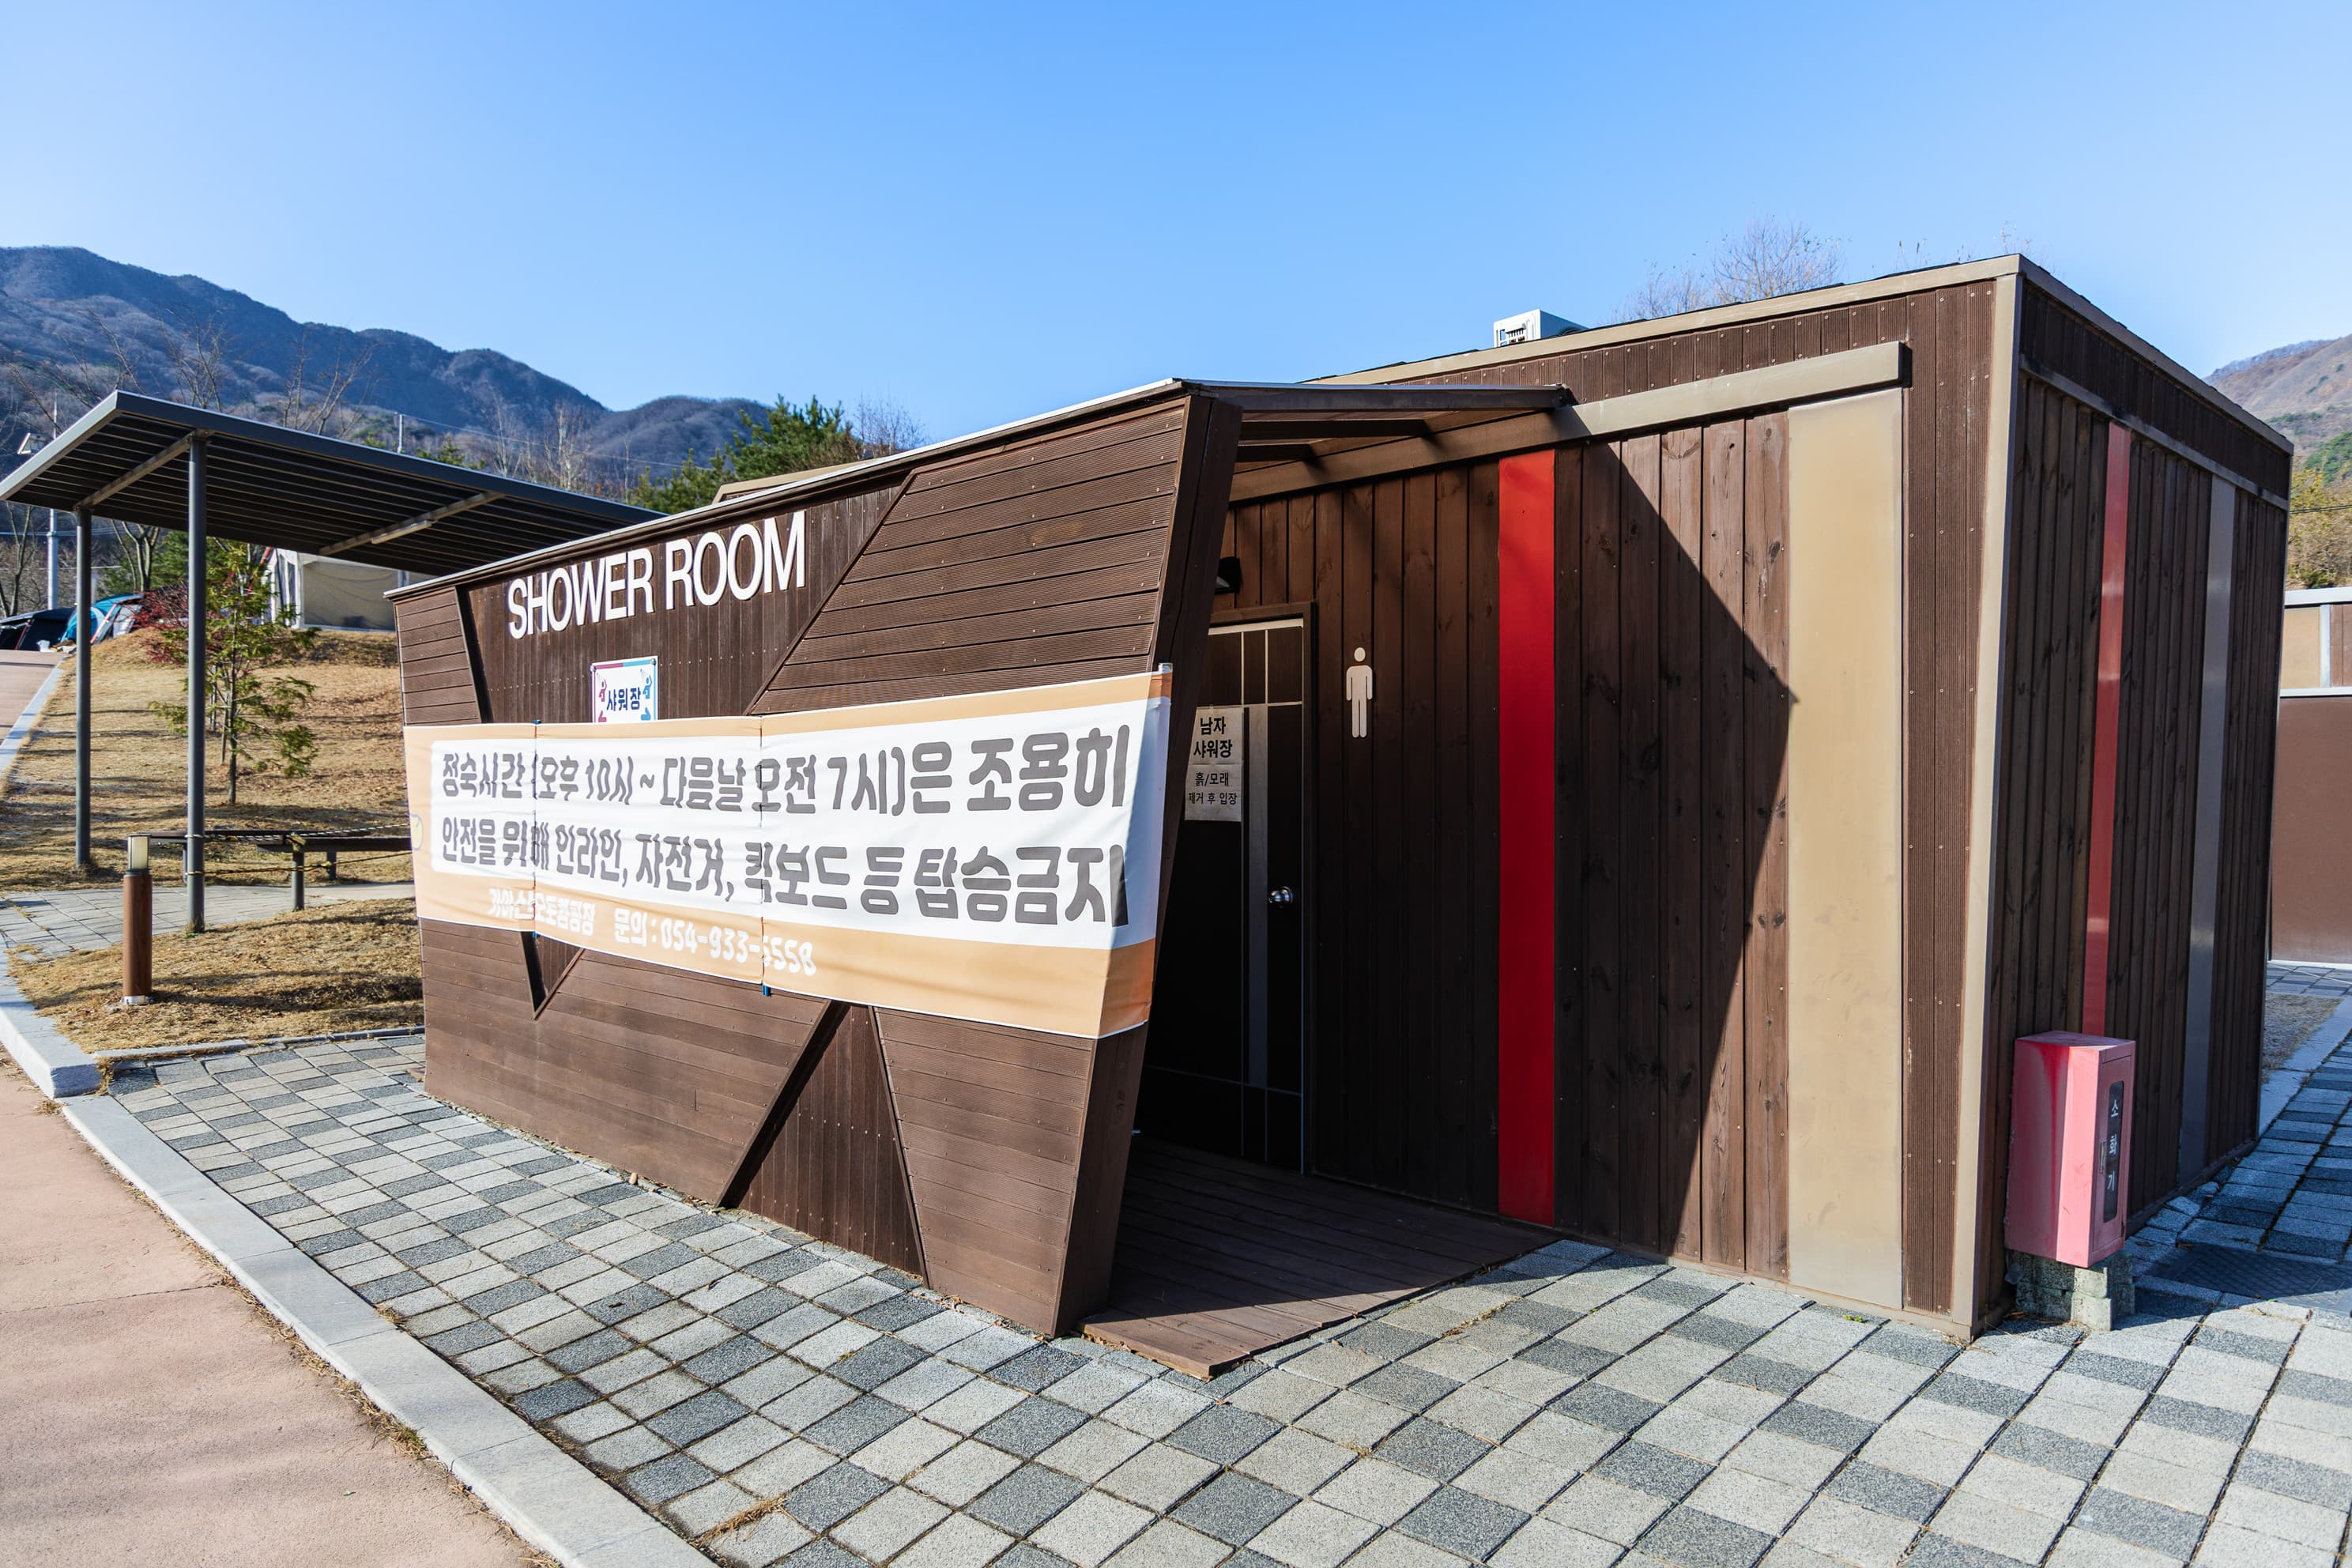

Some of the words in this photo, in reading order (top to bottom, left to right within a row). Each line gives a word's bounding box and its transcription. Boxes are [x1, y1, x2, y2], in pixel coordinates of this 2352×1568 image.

[507, 548, 655, 639] SHOWER
[665, 511, 806, 610] ROOM
[606, 687, 641, 711] 샤워장
[1200, 716, 1226, 736] 남자
[1193, 739, 1233, 759] 샤워장
[443, 752, 525, 799] 정숙시간
[585, 756, 635, 806] 10시
[661, 756, 746, 812] 다음날
[751, 753, 817, 815] 오전
[827, 741, 953, 817] 7시)은
[967, 724, 1131, 812] 조용히
[1195, 771, 1229, 786] 흙/모래
[1188, 792, 1204, 805] 제거
[1207, 792, 1216, 805] 후
[1219, 792, 1238, 805] 입장
[443, 816, 496, 867] 안전을
[503, 820, 550, 872] 위해
[555, 823, 628, 888] 인라인,
[635, 832, 735, 903] 자전거,
[744, 841, 850, 910] 킥보드
[860, 846, 906, 916] 등
[914, 844, 1130, 928] 탑승금지
